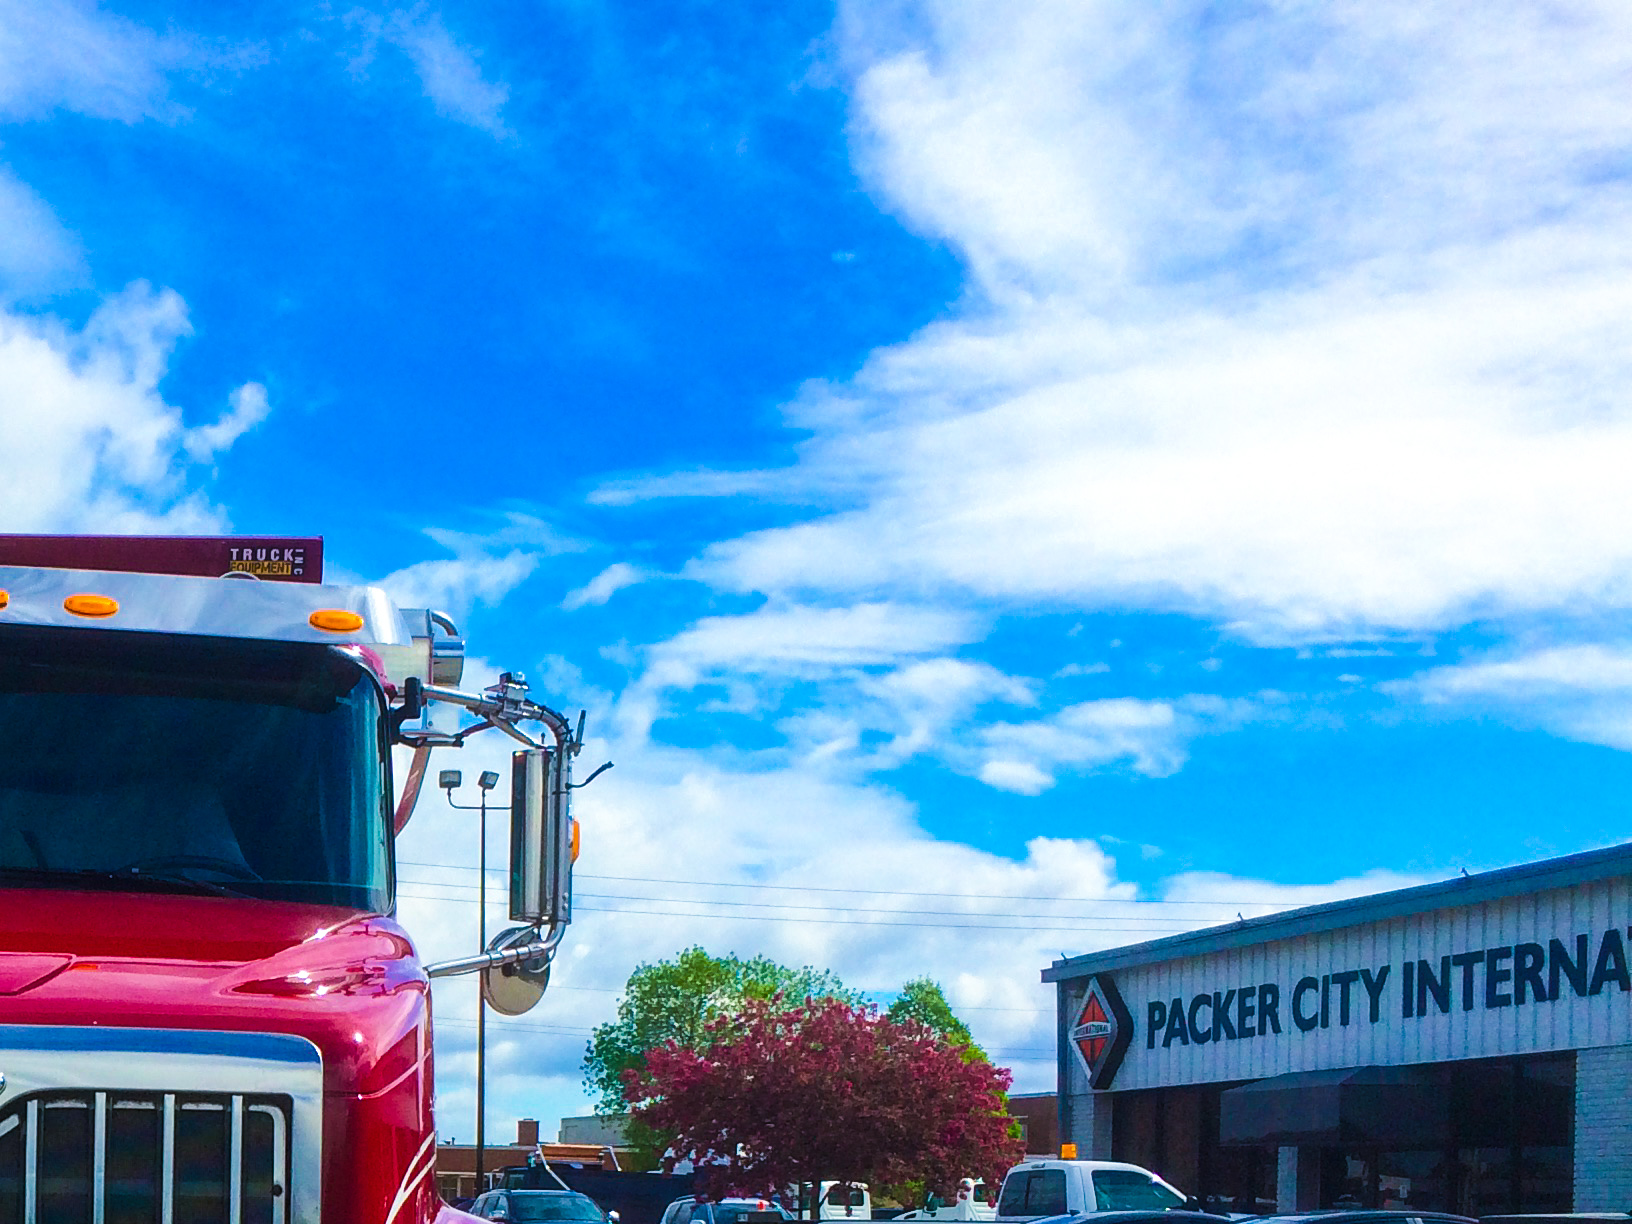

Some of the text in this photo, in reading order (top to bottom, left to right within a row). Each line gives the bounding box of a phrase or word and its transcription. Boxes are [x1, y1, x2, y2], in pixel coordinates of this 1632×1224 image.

[230, 548, 294, 561] TRUCK
[293, 548, 304, 575] INC
[230, 561, 292, 574] EQUIPMENT
[1146, 926, 1632, 1049] PACKER CITY INTERNA
